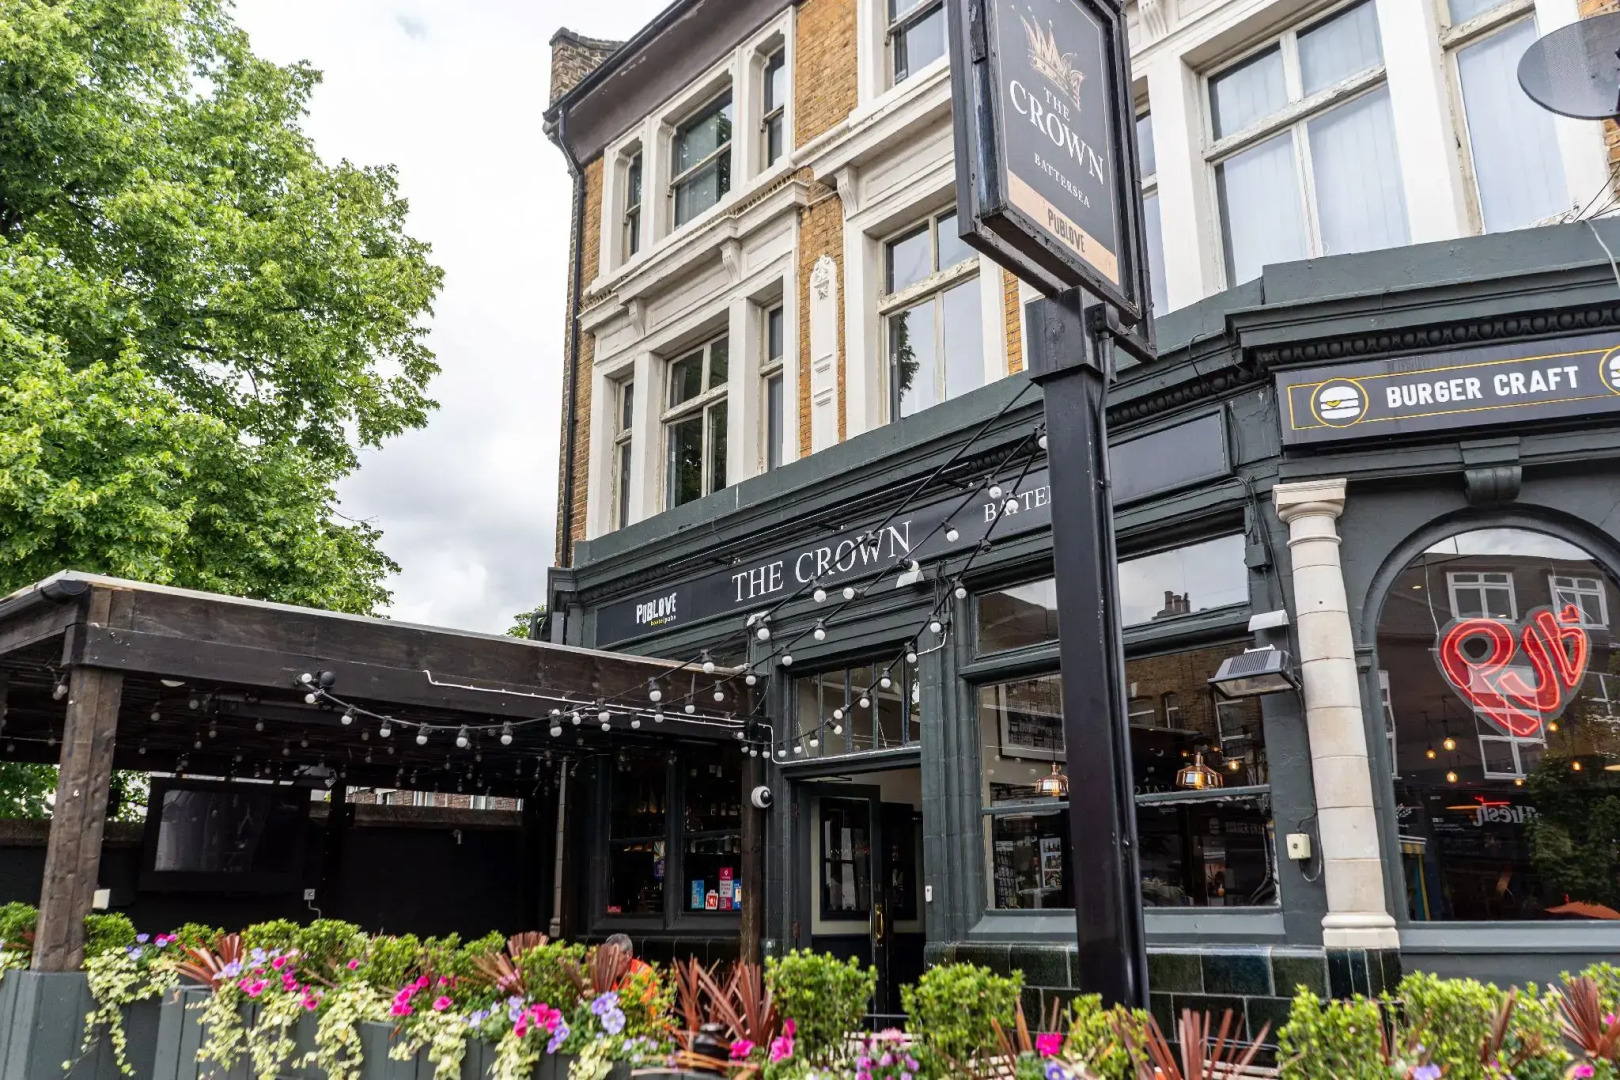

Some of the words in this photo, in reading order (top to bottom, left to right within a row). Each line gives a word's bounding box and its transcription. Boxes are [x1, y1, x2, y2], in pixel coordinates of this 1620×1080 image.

[1044, 86, 1070, 122] THE
[1009, 80, 1104, 186] CROWN
[1034, 153, 1091, 209] BATTERSEA
[1047, 208, 1086, 253] PUBLOVE
[1386, 377, 1482, 409] BURGER
[1493, 365, 1579, 397] CRAFT
[732, 561, 784, 602] THE
[795, 521, 912, 583] CROWN
[636, 592, 677, 624] PUBLOVE
